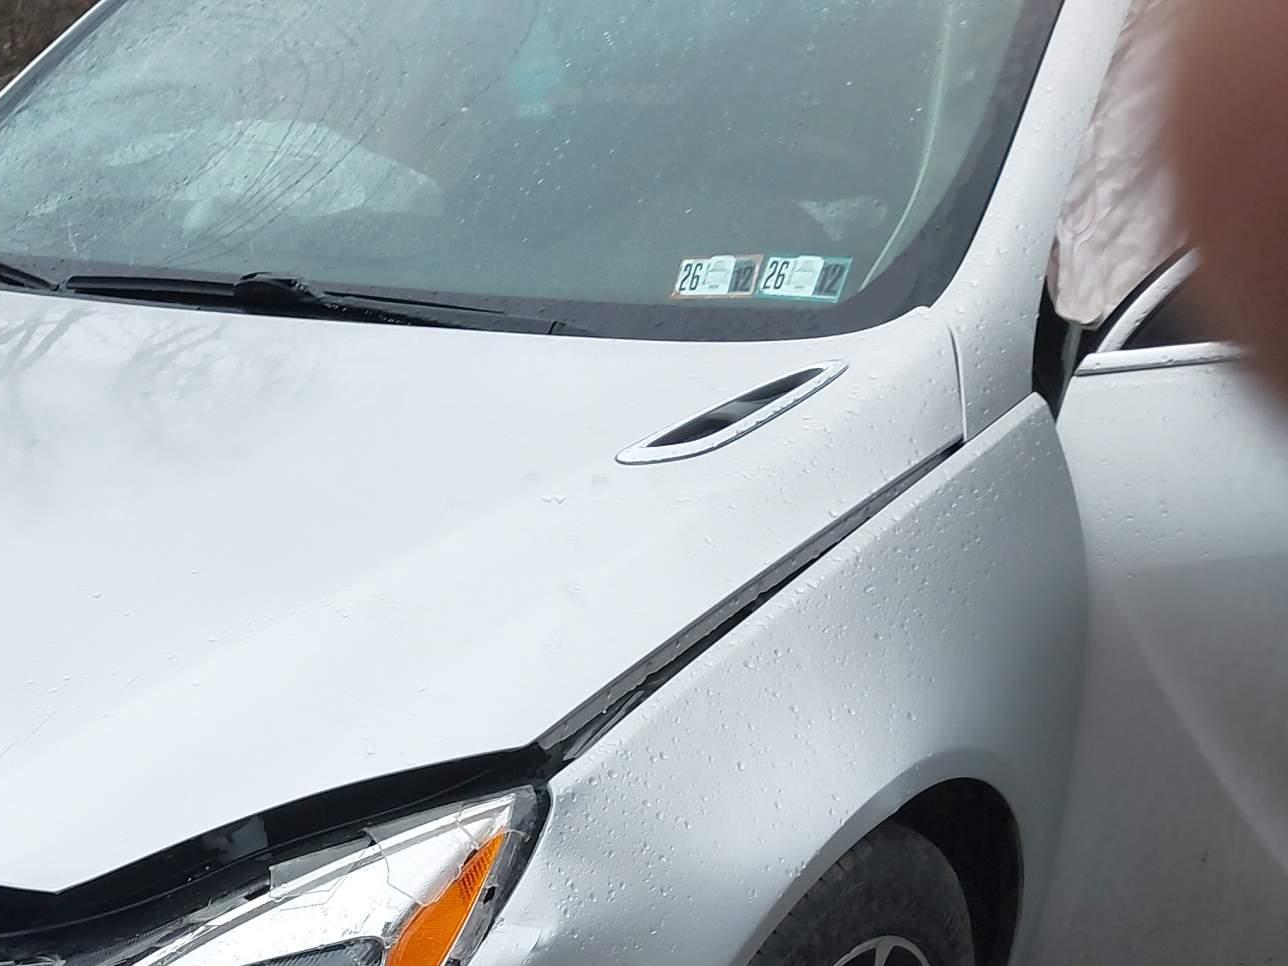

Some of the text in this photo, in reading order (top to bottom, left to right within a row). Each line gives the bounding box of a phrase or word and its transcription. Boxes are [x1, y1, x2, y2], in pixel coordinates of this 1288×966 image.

[678, 263, 754, 293] 26 12
[762, 261, 845, 294] 26 12
